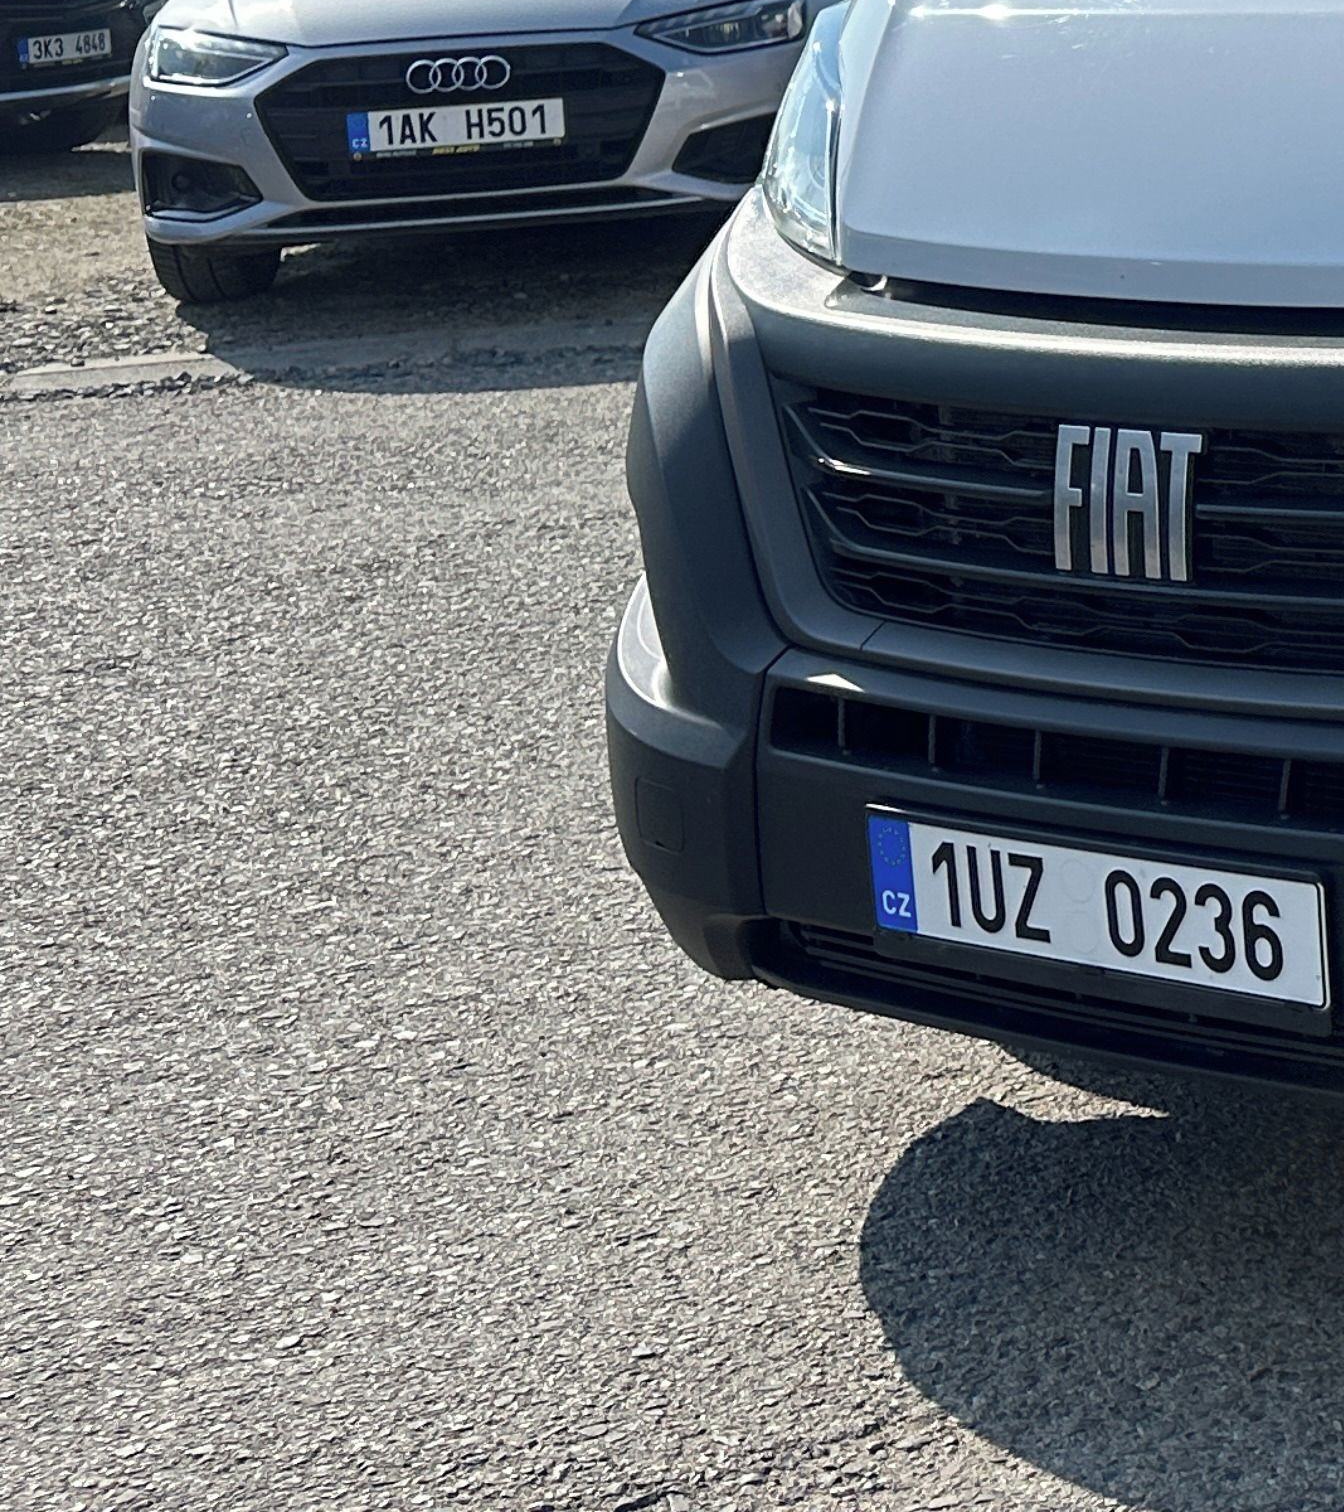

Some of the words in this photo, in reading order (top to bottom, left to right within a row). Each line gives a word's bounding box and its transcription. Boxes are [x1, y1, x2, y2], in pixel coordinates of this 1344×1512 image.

[33, 37, 64, 60] 3K3
[379, 111, 438, 145] 1AK
[465, 103, 546, 140] H501
[1053, 424, 1203, 582] FIAT
[881, 890, 912, 919] CZ
[931, 842, 1052, 944] 1UZ
[1104, 869, 1284, 982] 0236
